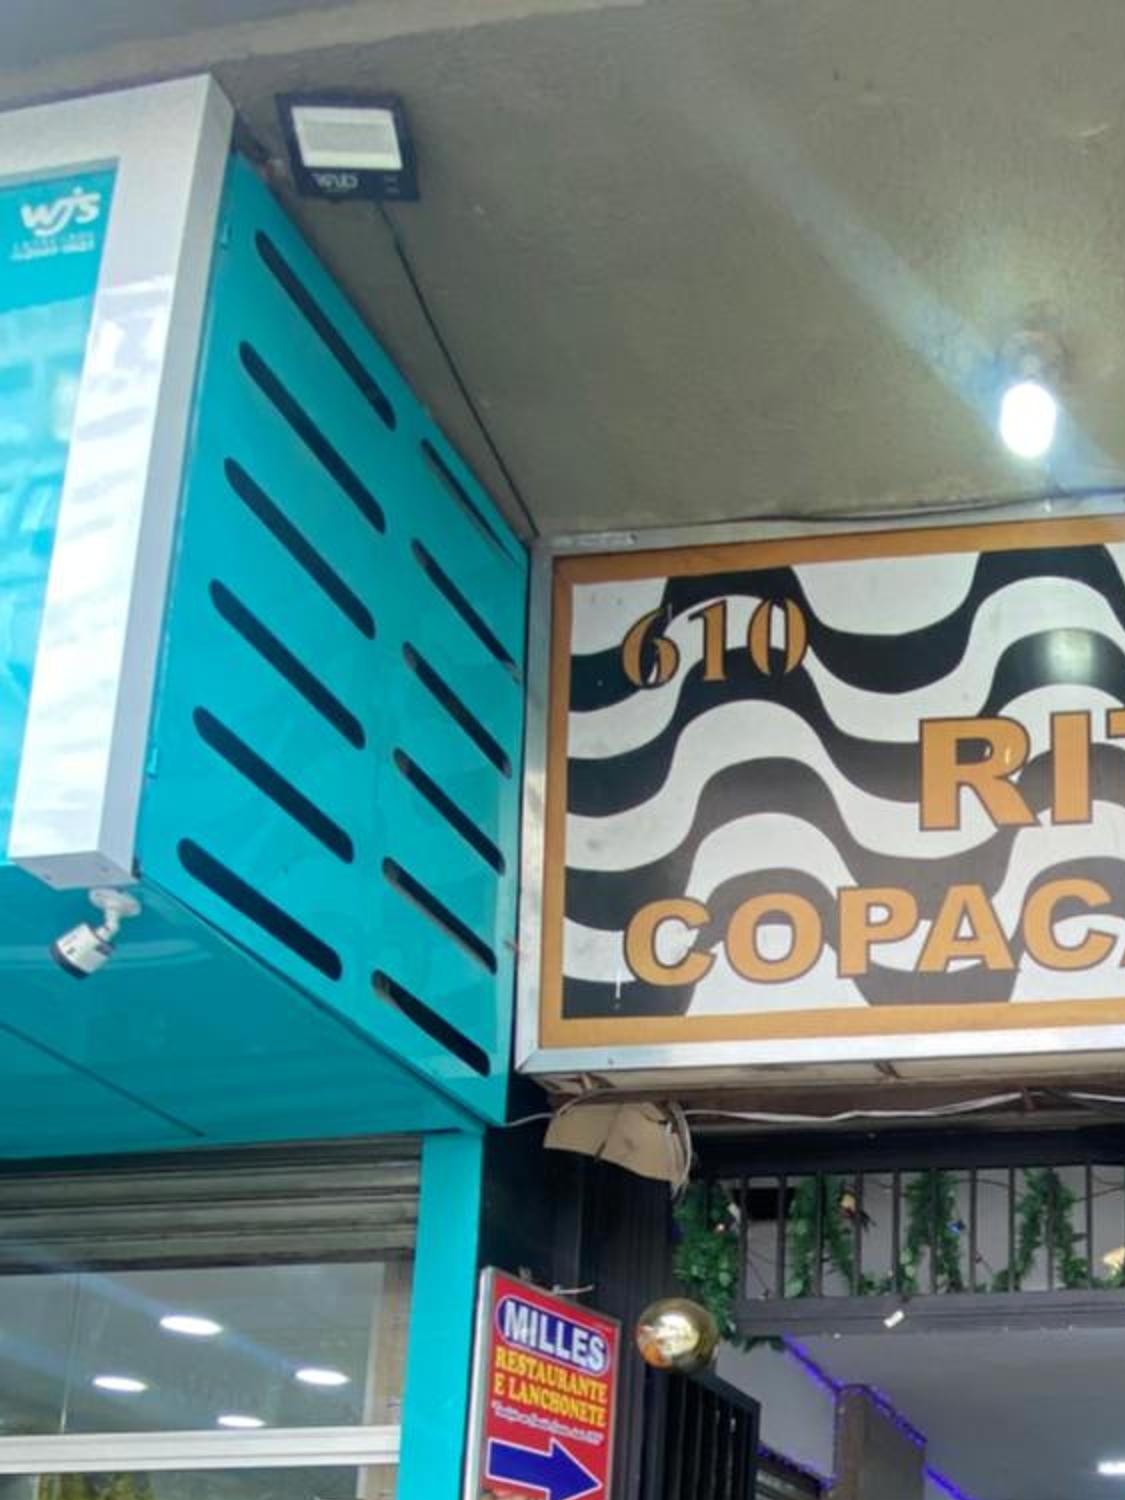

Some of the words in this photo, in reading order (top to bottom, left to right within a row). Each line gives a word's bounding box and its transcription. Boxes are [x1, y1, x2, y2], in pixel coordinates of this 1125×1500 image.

[622, 595, 809, 689] 610
[504, 1299, 605, 1372] MILLES
[494, 1372, 505, 1396] E
[508, 1377, 607, 1428] LANCHONETE
[495, 1345, 608, 1404] RESTAURANTE
